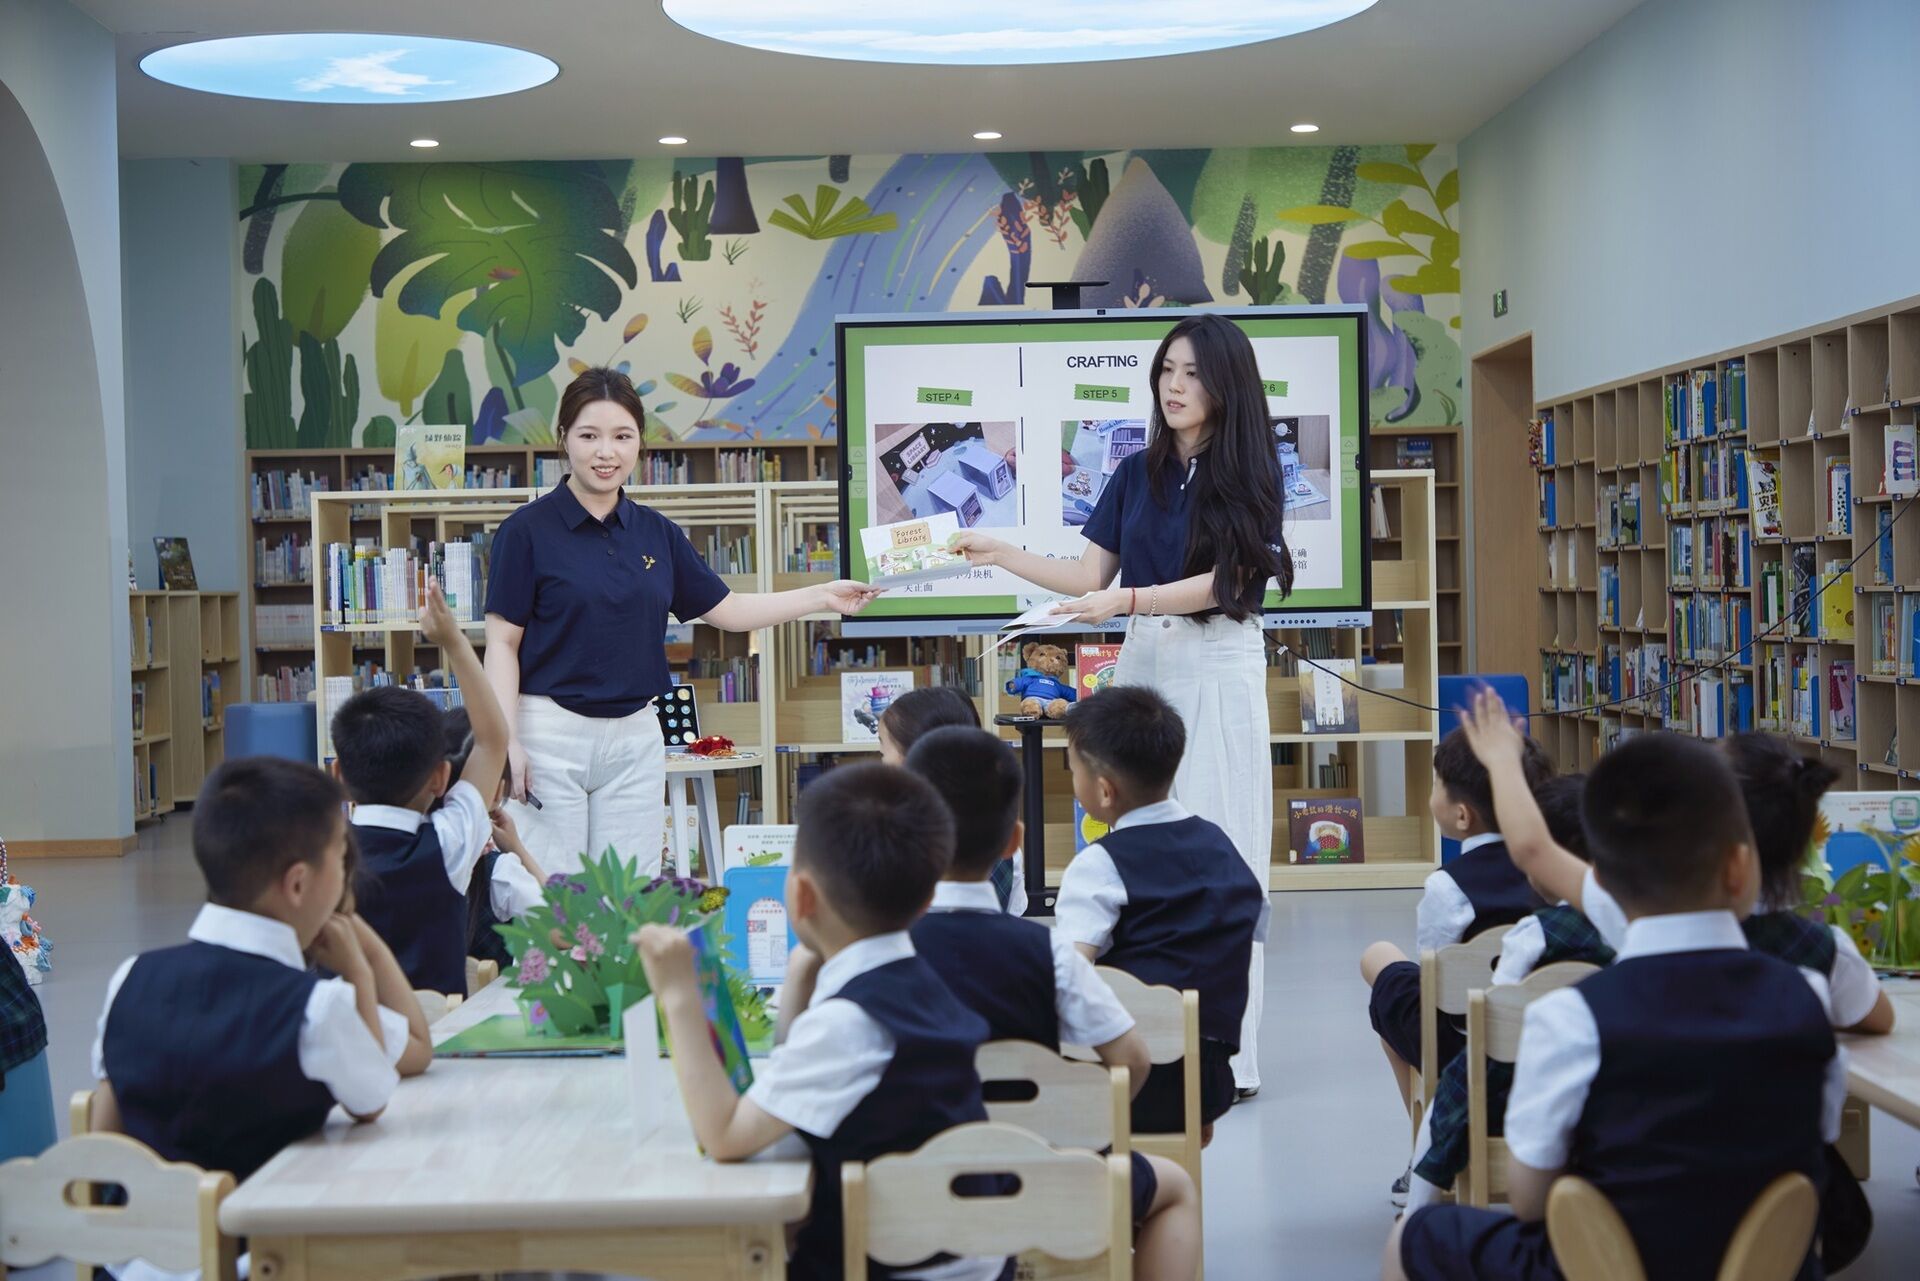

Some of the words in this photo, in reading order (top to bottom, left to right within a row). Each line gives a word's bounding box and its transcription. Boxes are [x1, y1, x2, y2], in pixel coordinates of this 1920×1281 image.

[1066, 355, 1138, 368] CRAFTING
[1269, 383, 1276, 393] 6
[925, 393, 951, 402] STEP
[953, 393, 960, 401] 4
[1083, 390, 1109, 400] STEP
[1111, 389, 1118, 398] 5
[906, 441, 922, 458] SPACE
[907, 445, 927, 465] LIBRARY
[896, 528, 922, 538] Forest
[897, 535, 926, 545] Library
